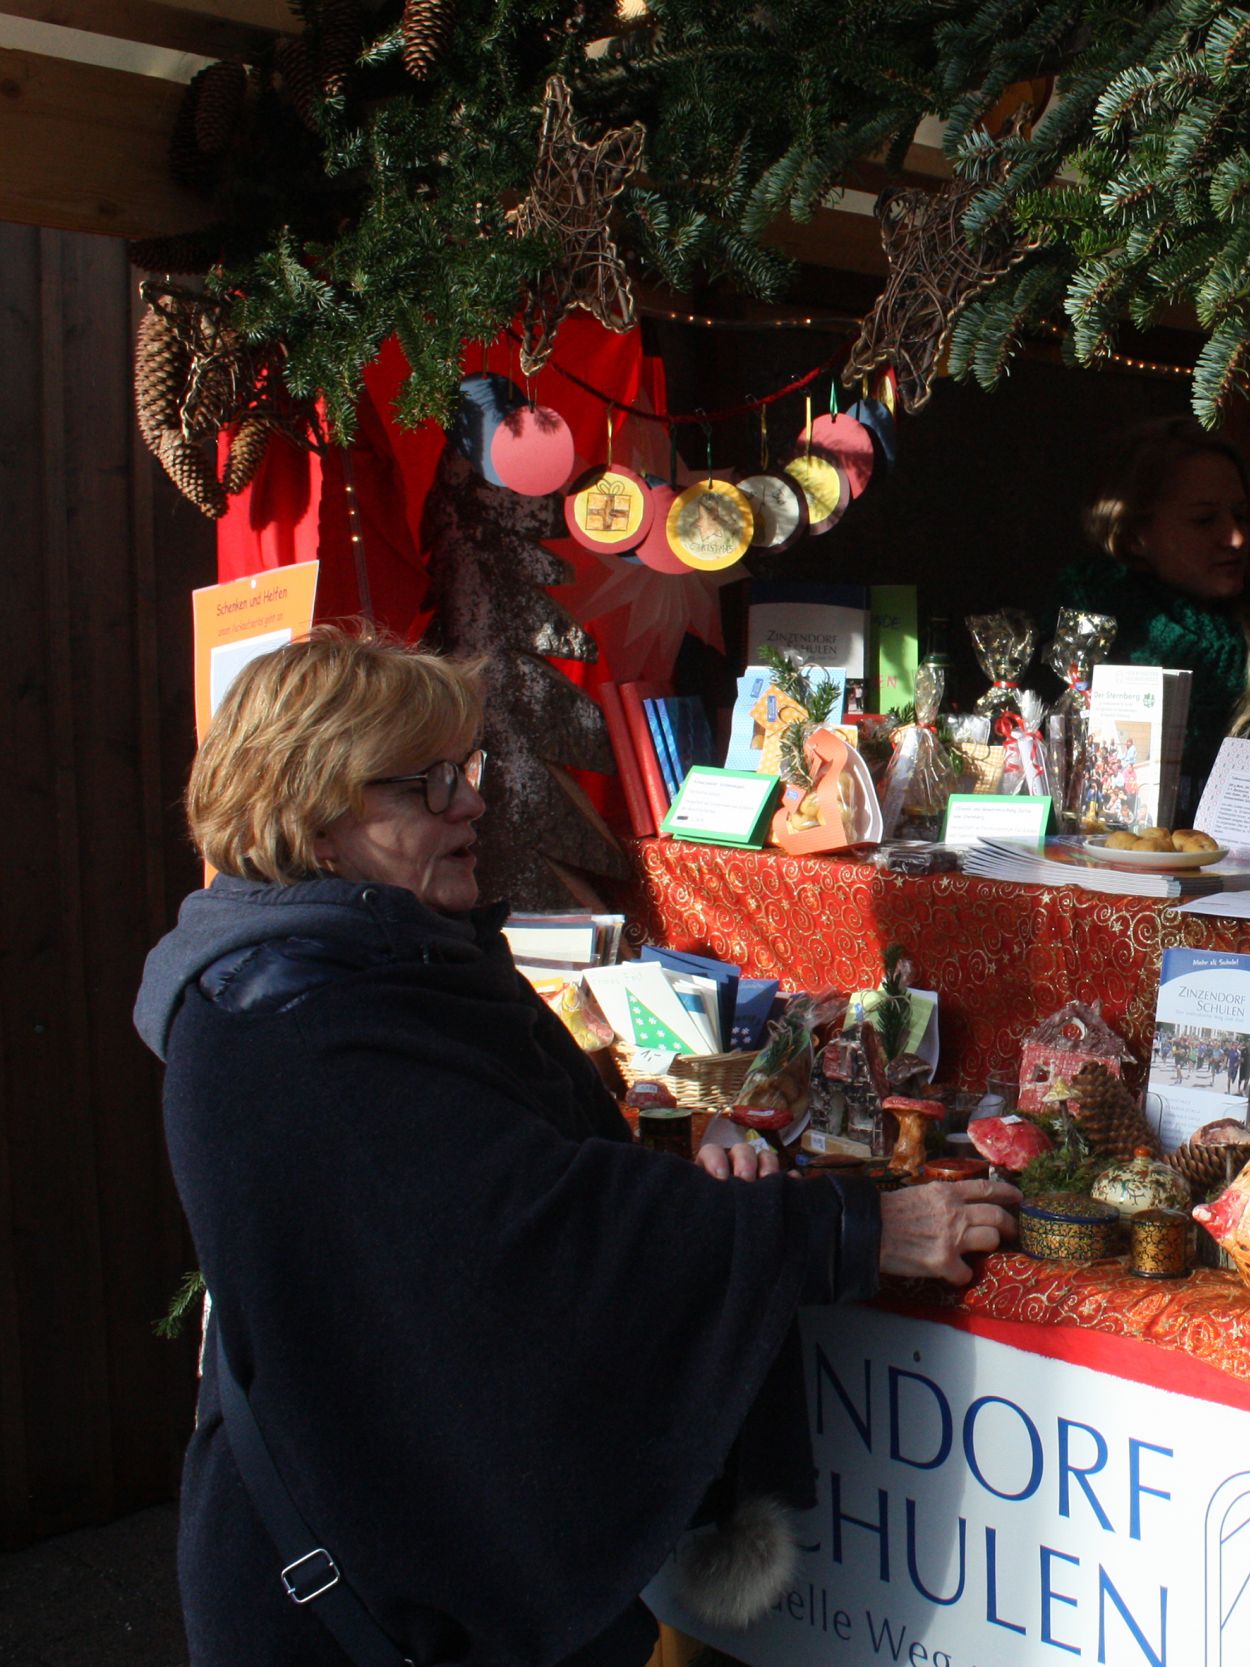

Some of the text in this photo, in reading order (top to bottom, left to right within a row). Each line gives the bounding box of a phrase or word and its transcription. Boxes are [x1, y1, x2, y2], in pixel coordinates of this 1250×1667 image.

[216, 586, 288, 617] Schenken und Helfen
[1106, 690, 1141, 703] Sternberg
[1178, 986, 1246, 1005] ZINZENDORF
[1197, 1000, 1246, 1017] SCHULEN
[798, 1470, 1168, 1667] HULEN
